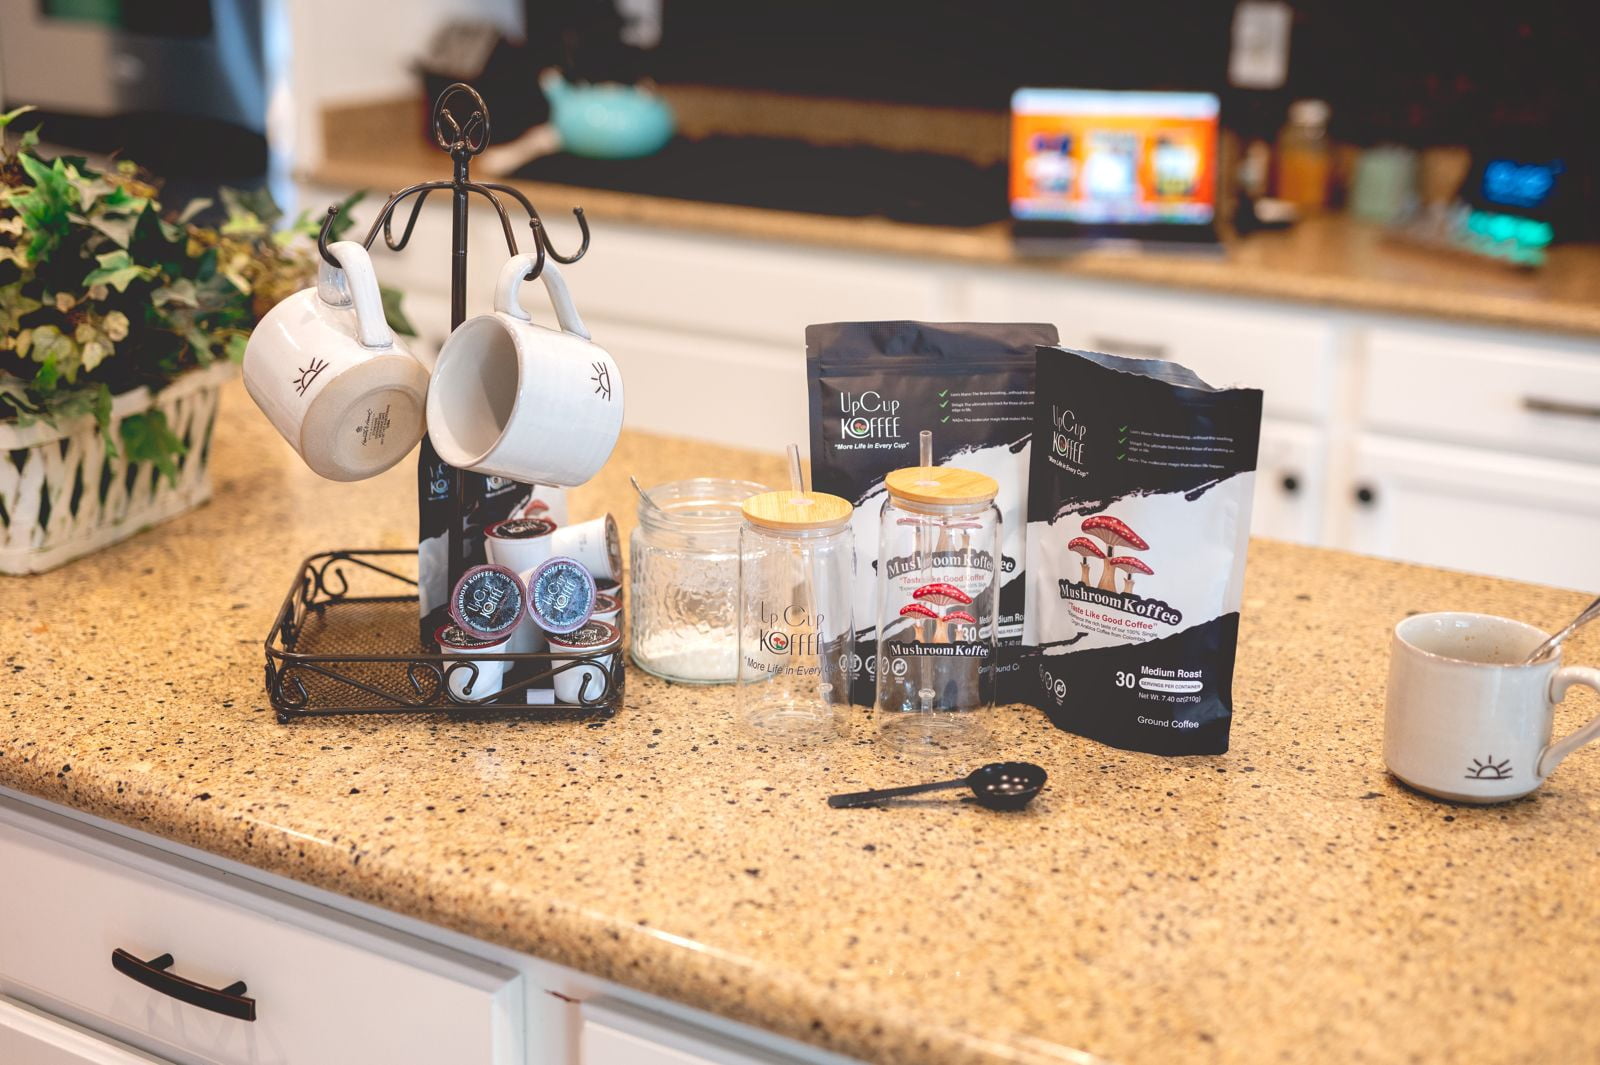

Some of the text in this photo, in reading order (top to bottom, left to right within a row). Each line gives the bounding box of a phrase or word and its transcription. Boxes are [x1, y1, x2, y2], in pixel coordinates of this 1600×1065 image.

[841, 416, 901, 440] KOFFEE
[1085, 609, 1100, 619] Like
[1101, 614, 1123, 625] Good
[767, 663, 783, 673] Life
[786, 666, 794, 675] in
[796, 665, 822, 676] Every
[1115, 665, 1202, 689] 30 Medium Roast
[1141, 680, 1164, 688] SERVINGS
[1138, 692, 1149, 700] Net
[1137, 715, 1200, 729] Ground Coffee
